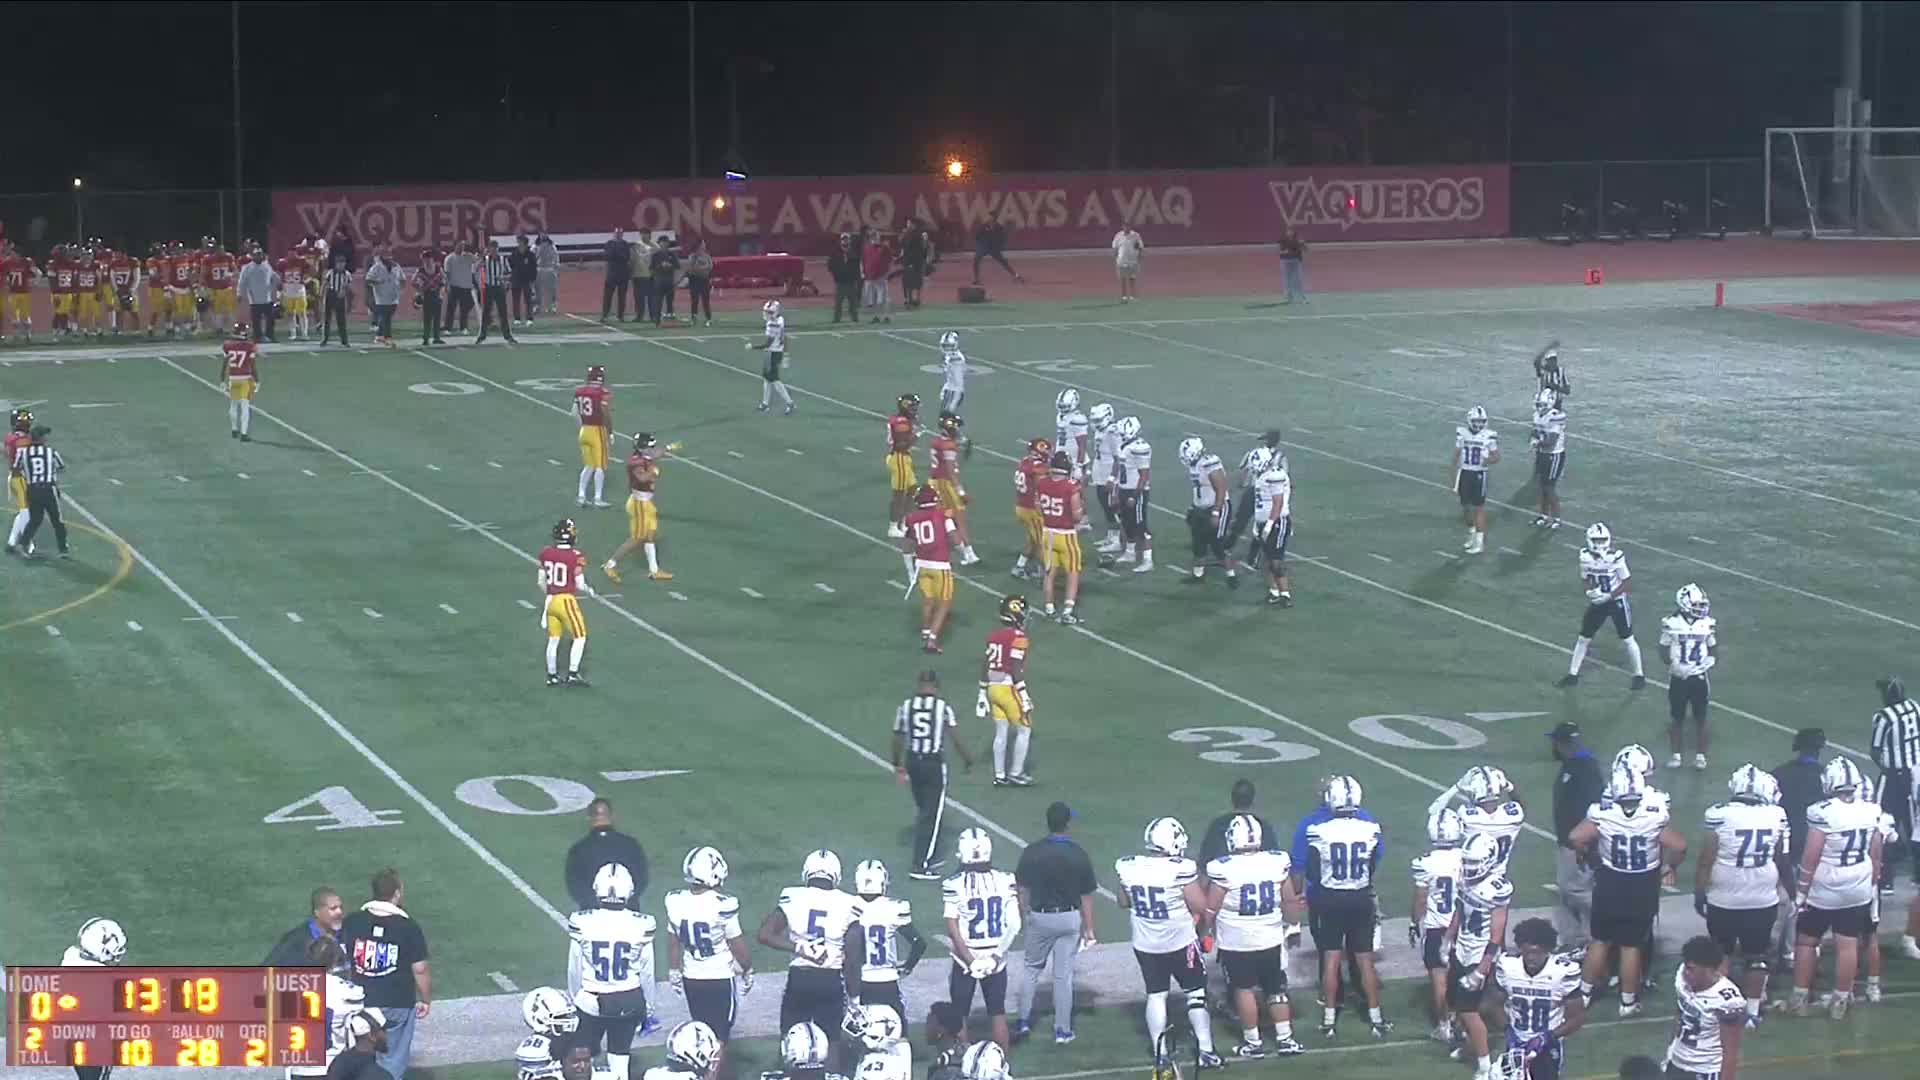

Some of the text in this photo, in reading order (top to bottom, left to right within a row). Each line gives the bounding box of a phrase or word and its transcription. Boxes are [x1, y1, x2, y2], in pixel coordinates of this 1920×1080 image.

[296, 195, 548, 250] VAQUEROS
[632, 194, 758, 236] ONCE
[771, 195, 804, 235] A
[808, 191, 896, 234] VAQ
[1079, 192, 1110, 227] A
[1112, 186, 1195, 228] VAQ
[1269, 177, 1484, 232] VAQUEROS
[9, 271, 23, 287] 71
[227, 350, 247, 368] 27
[577, 396, 593, 417] 13
[31, 457, 45, 475] B
[1463, 446, 1482, 466] 18
[1039, 494, 1064, 517] 25
[913, 520, 936, 545] 10
[543, 560, 568, 587] 30
[985, 642, 1002, 668] 21
[1679, 639, 1703, 667] 14
[912, 712, 932, 738] S
[1901, 710, 1920, 741] H
[1329, 841, 1368, 881] 86
[1610, 834, 1648, 871] 66
[1735, 828, 1773, 869] 75
[1840, 828, 1869, 867] 71
[1130, 884, 1169, 920] 65
[1238, 880, 1275, 916] 68
[1434, 876, 1453, 915] 3
[679, 918, 717, 961] 46
[806, 909, 829, 945] 5
[591, 941, 632, 983] 56
[864, 925, 887, 967] 3
[1513, 997, 1550, 1032] 30
